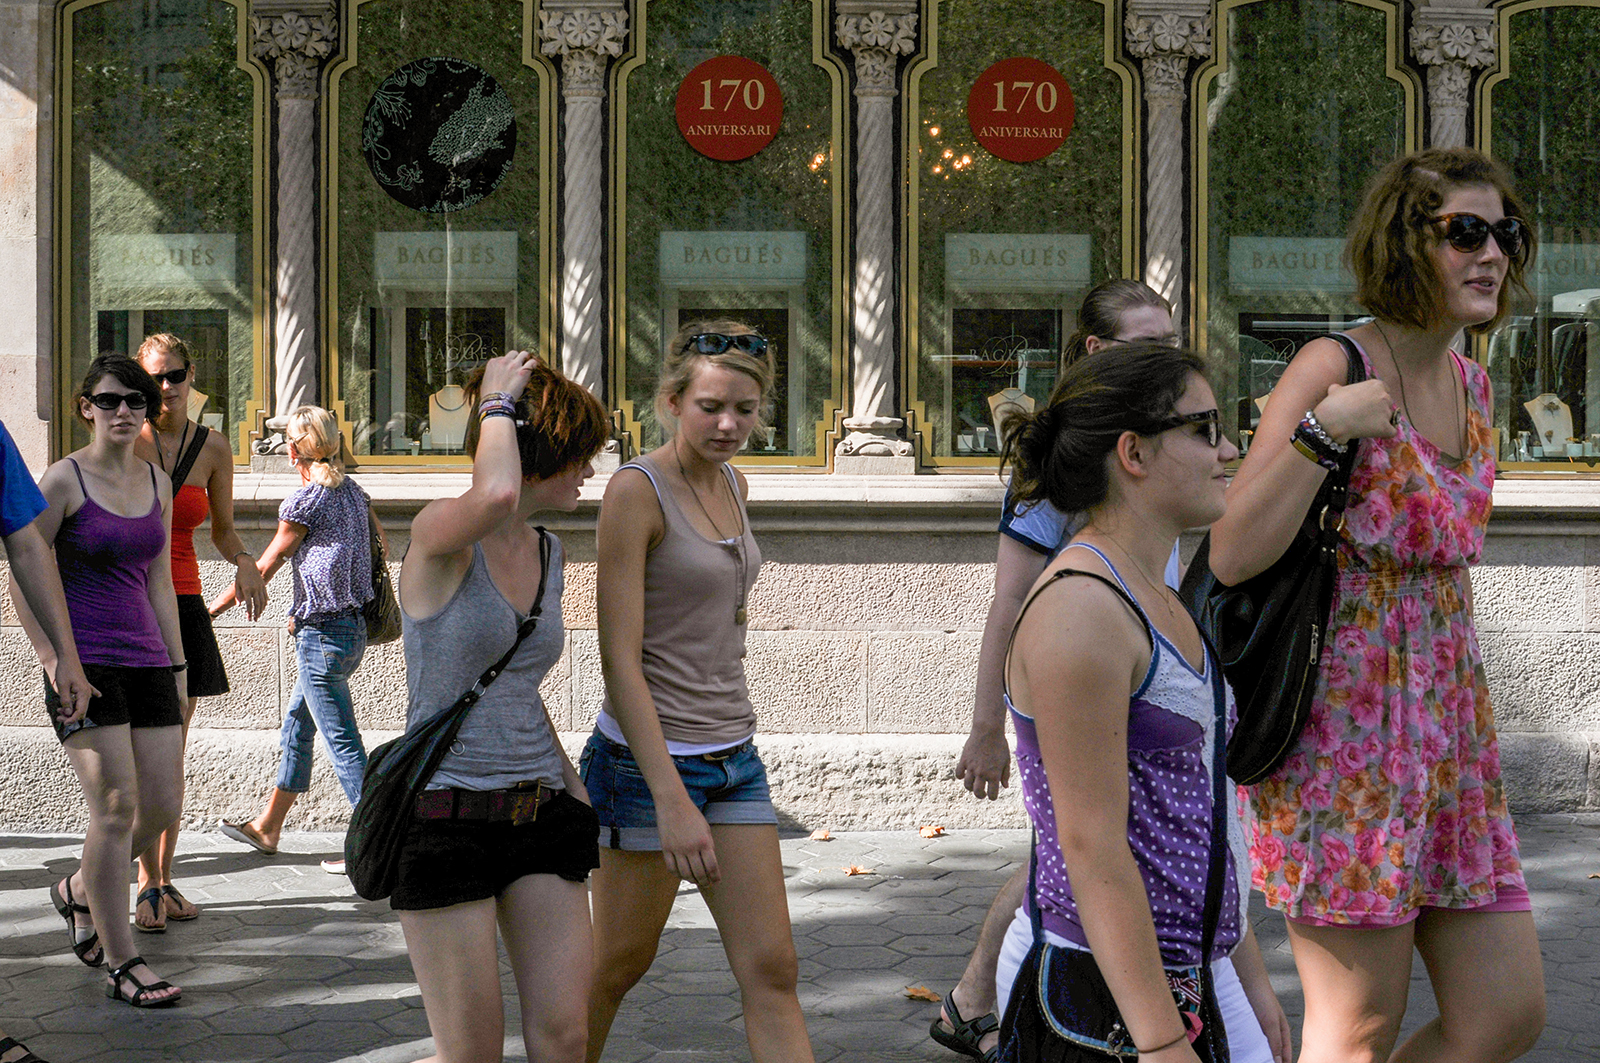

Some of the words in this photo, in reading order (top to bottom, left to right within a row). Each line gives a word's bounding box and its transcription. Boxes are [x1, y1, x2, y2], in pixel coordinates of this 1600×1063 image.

[699, 78, 766, 112] 170
[991, 80, 1058, 114] 170
[686, 124, 772, 136] ANIVERSARI
[978, 125, 1064, 139] ANIVERSARI
[397, 242, 497, 265] BAGUÉS
[682, 243, 783, 264] BAGUÉS
[968, 244, 1068, 267] BAGUÉS
